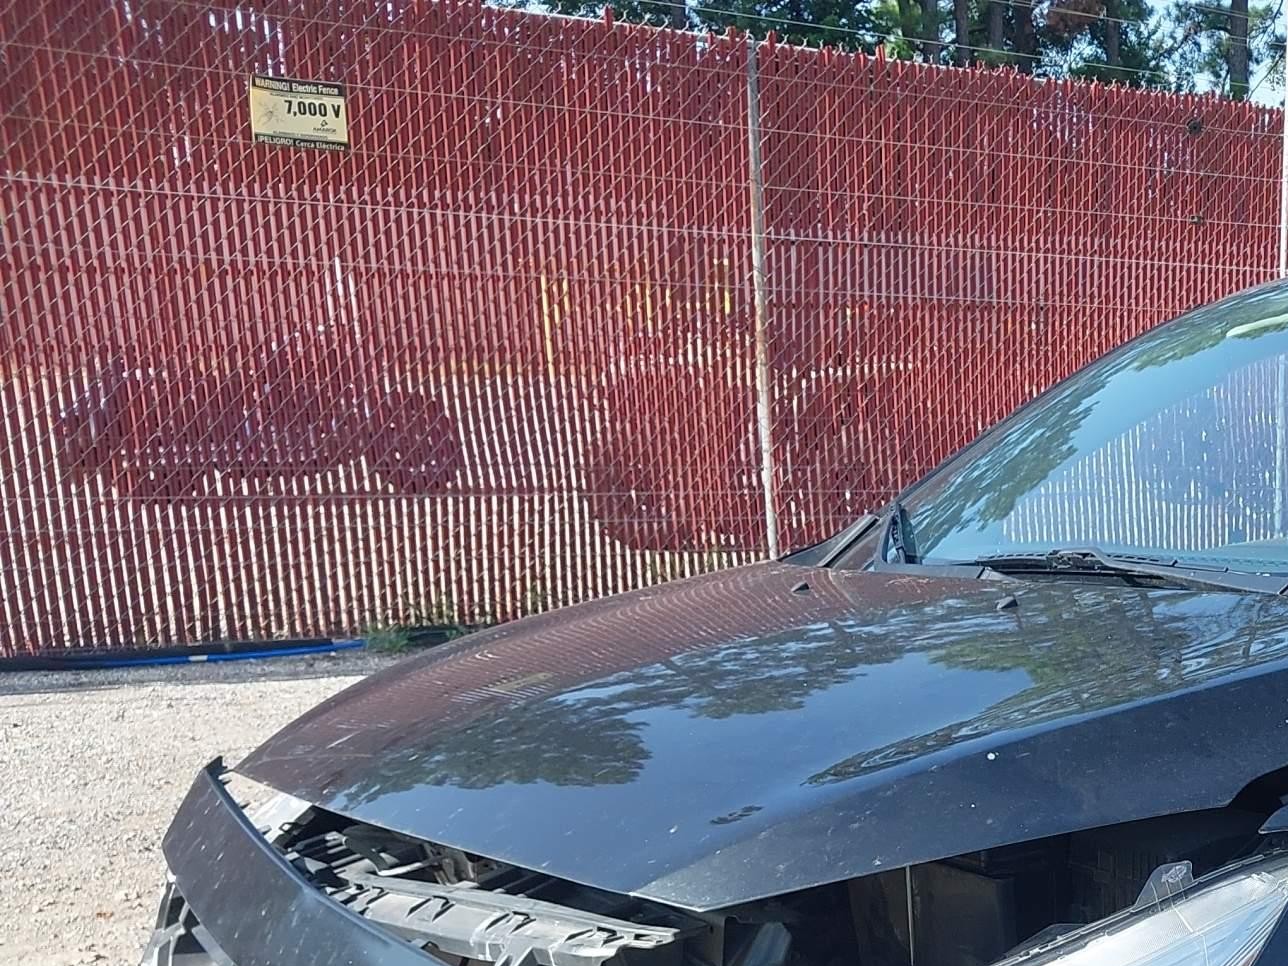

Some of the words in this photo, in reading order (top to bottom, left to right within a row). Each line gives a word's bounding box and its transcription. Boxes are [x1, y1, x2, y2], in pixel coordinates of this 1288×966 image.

[255, 78, 290, 91] WARNING!
[292, 84, 317, 93] Electric
[318, 85, 338, 95] Fence
[284, 100, 327, 117] 7,000
[331, 104, 341, 119] V
[295, 140, 315, 149] Cerca
